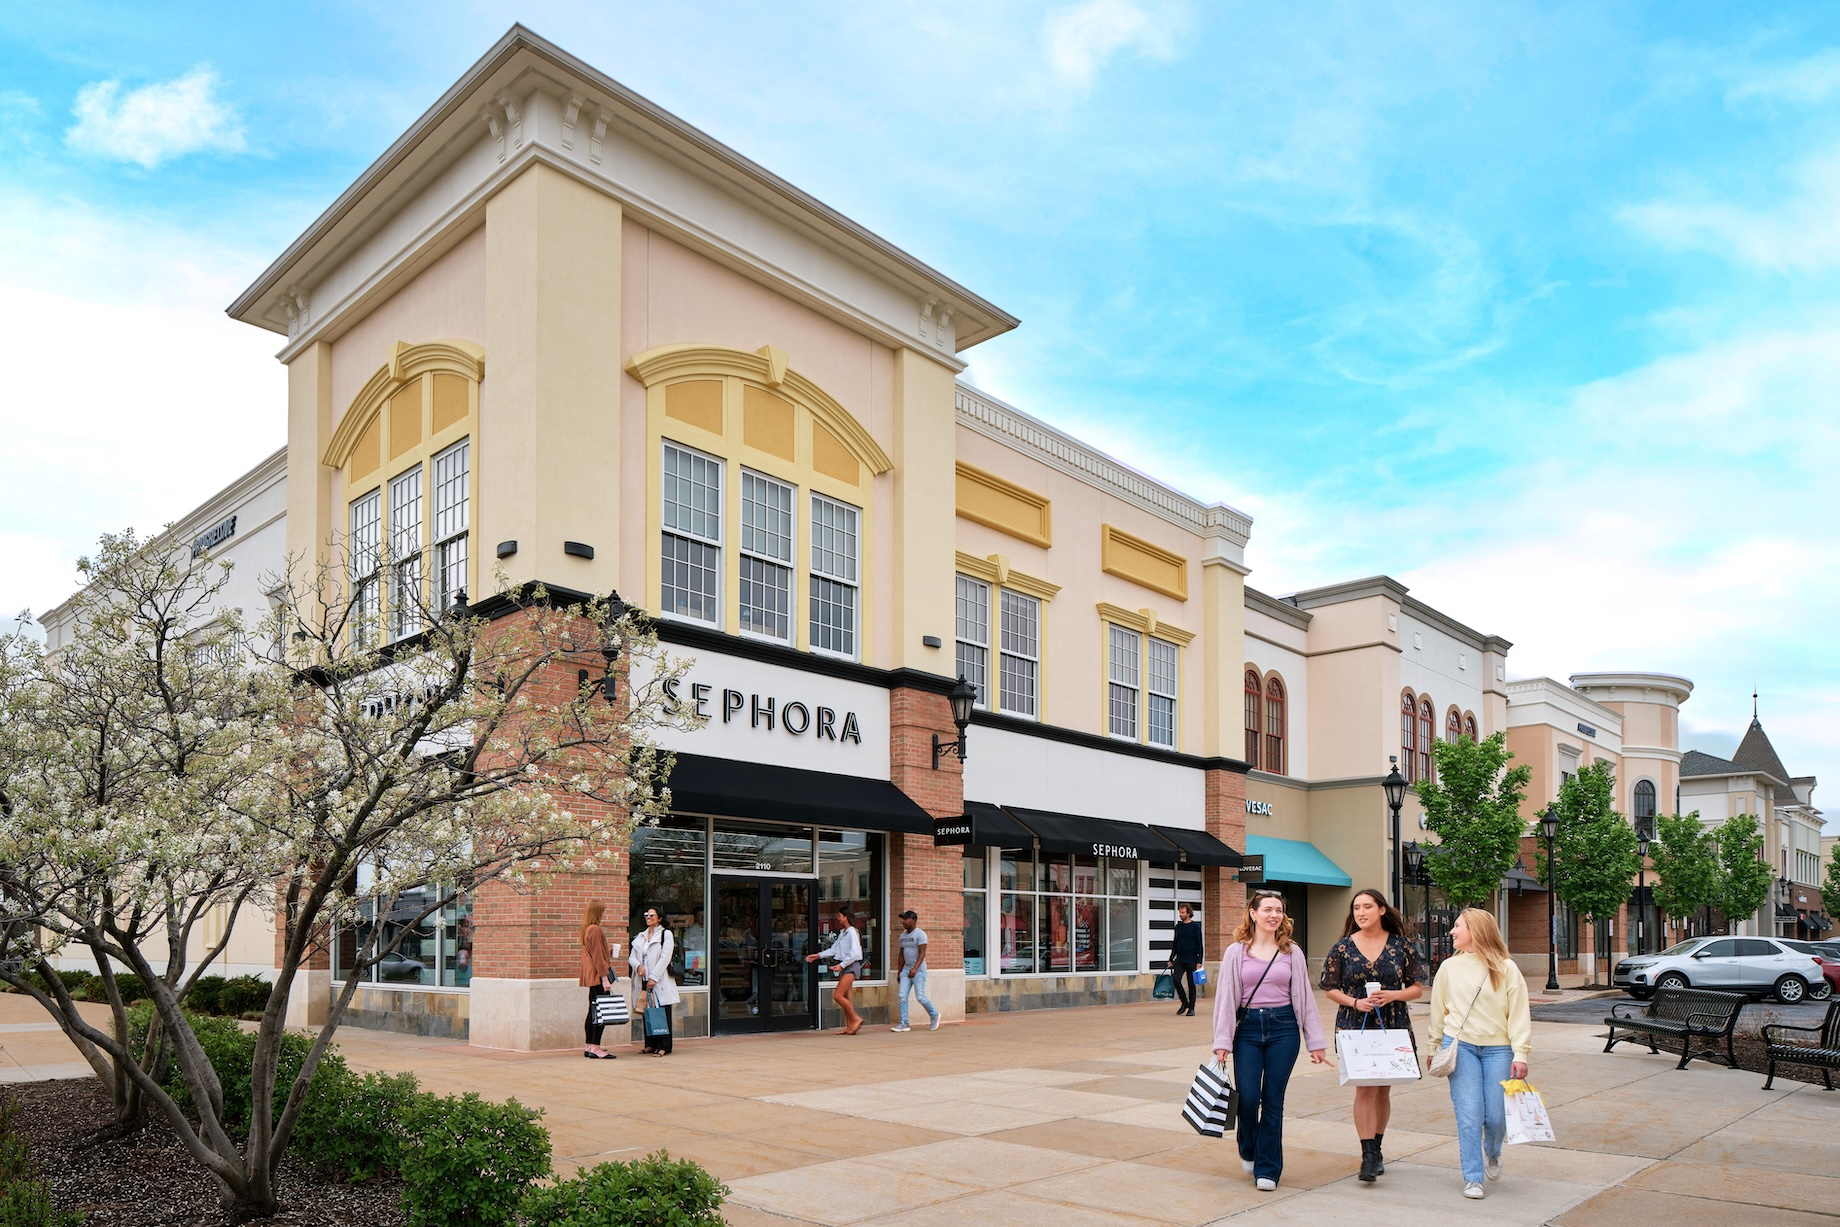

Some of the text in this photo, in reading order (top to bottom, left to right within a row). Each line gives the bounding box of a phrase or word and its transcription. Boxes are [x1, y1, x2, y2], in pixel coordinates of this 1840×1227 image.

[662, 678, 863, 745] SEPHORA
[937, 826, 971, 836] SEPHORA
[1092, 843, 1138, 859] SEPHORA
[755, 862, 772, 870] 2110
